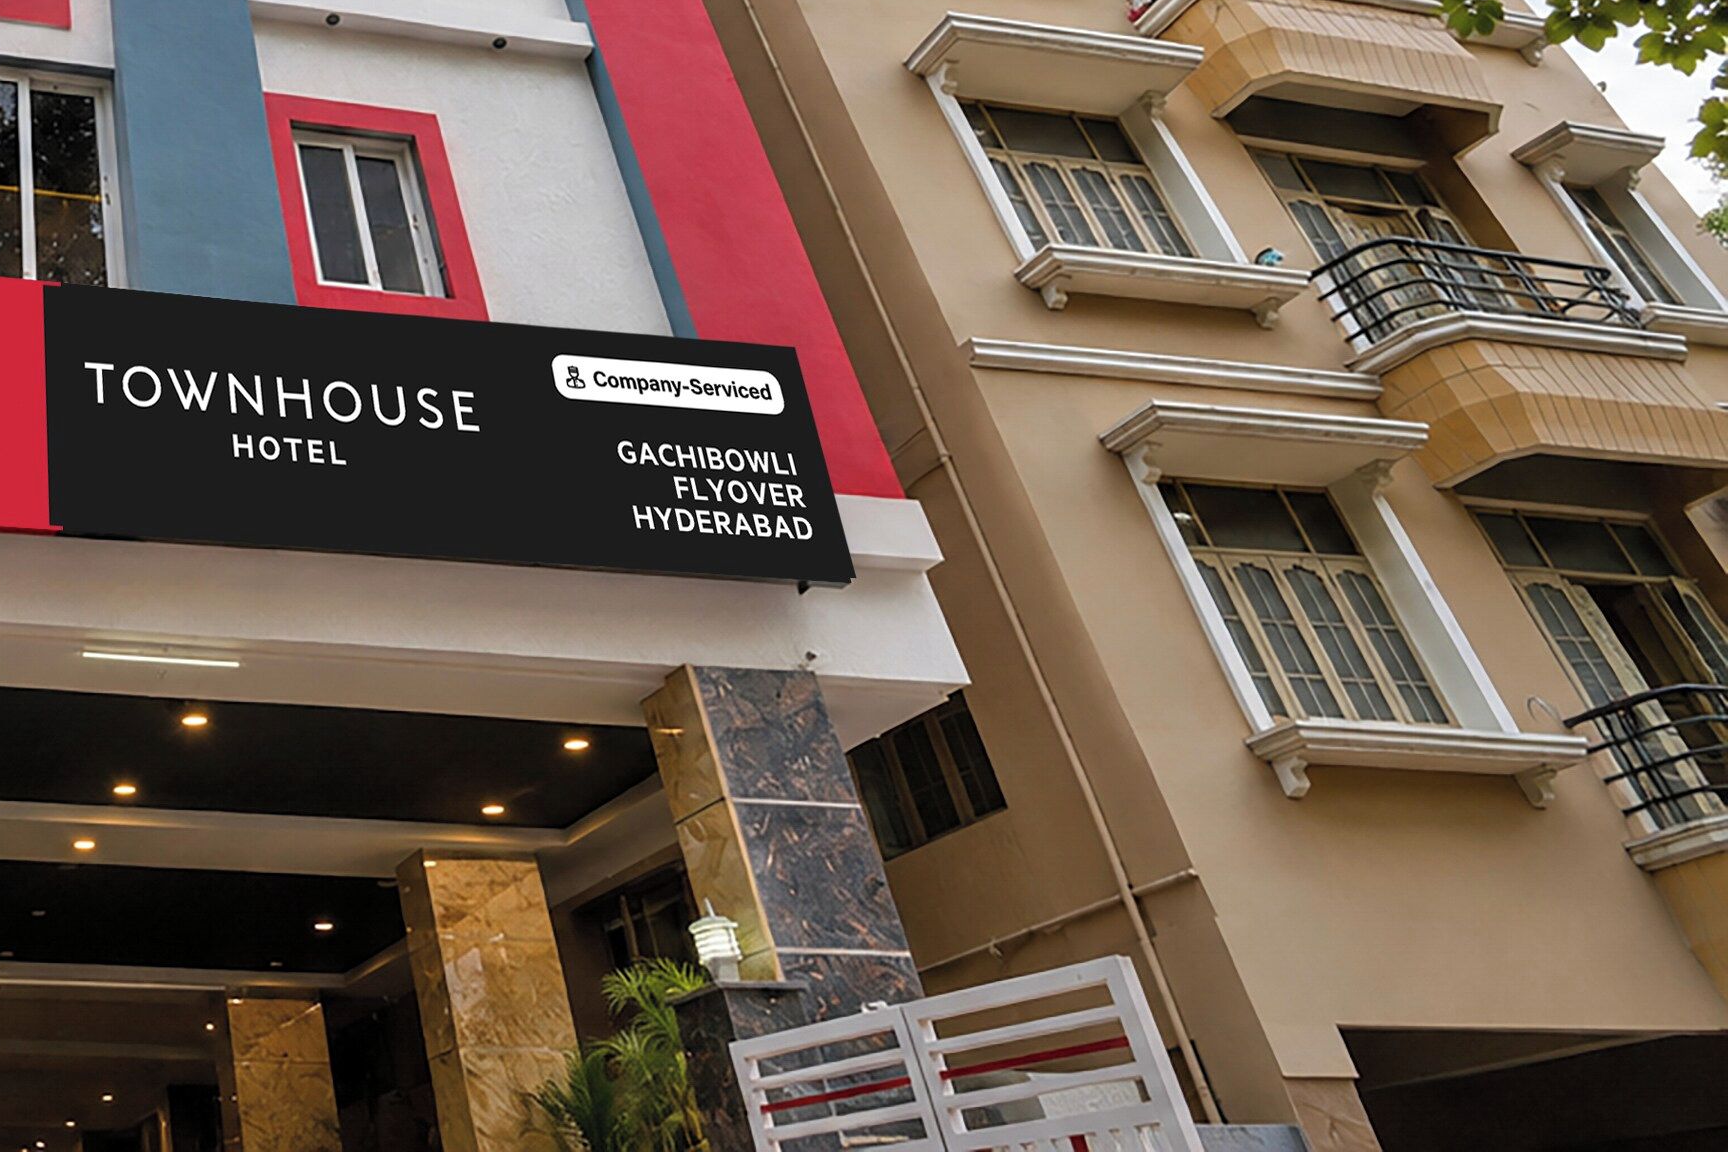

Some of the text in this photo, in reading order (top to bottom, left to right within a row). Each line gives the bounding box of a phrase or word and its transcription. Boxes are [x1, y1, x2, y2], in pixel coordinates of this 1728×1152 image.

[84, 361, 480, 432] TOWNHOUSE
[592, 370, 773, 402] Company-Serviced
[232, 433, 348, 466] HOTEL
[617, 440, 798, 476] GACHIBOWLI
[673, 476, 807, 508] FLYOVER
[632, 505, 813, 540] HYDERABAD
